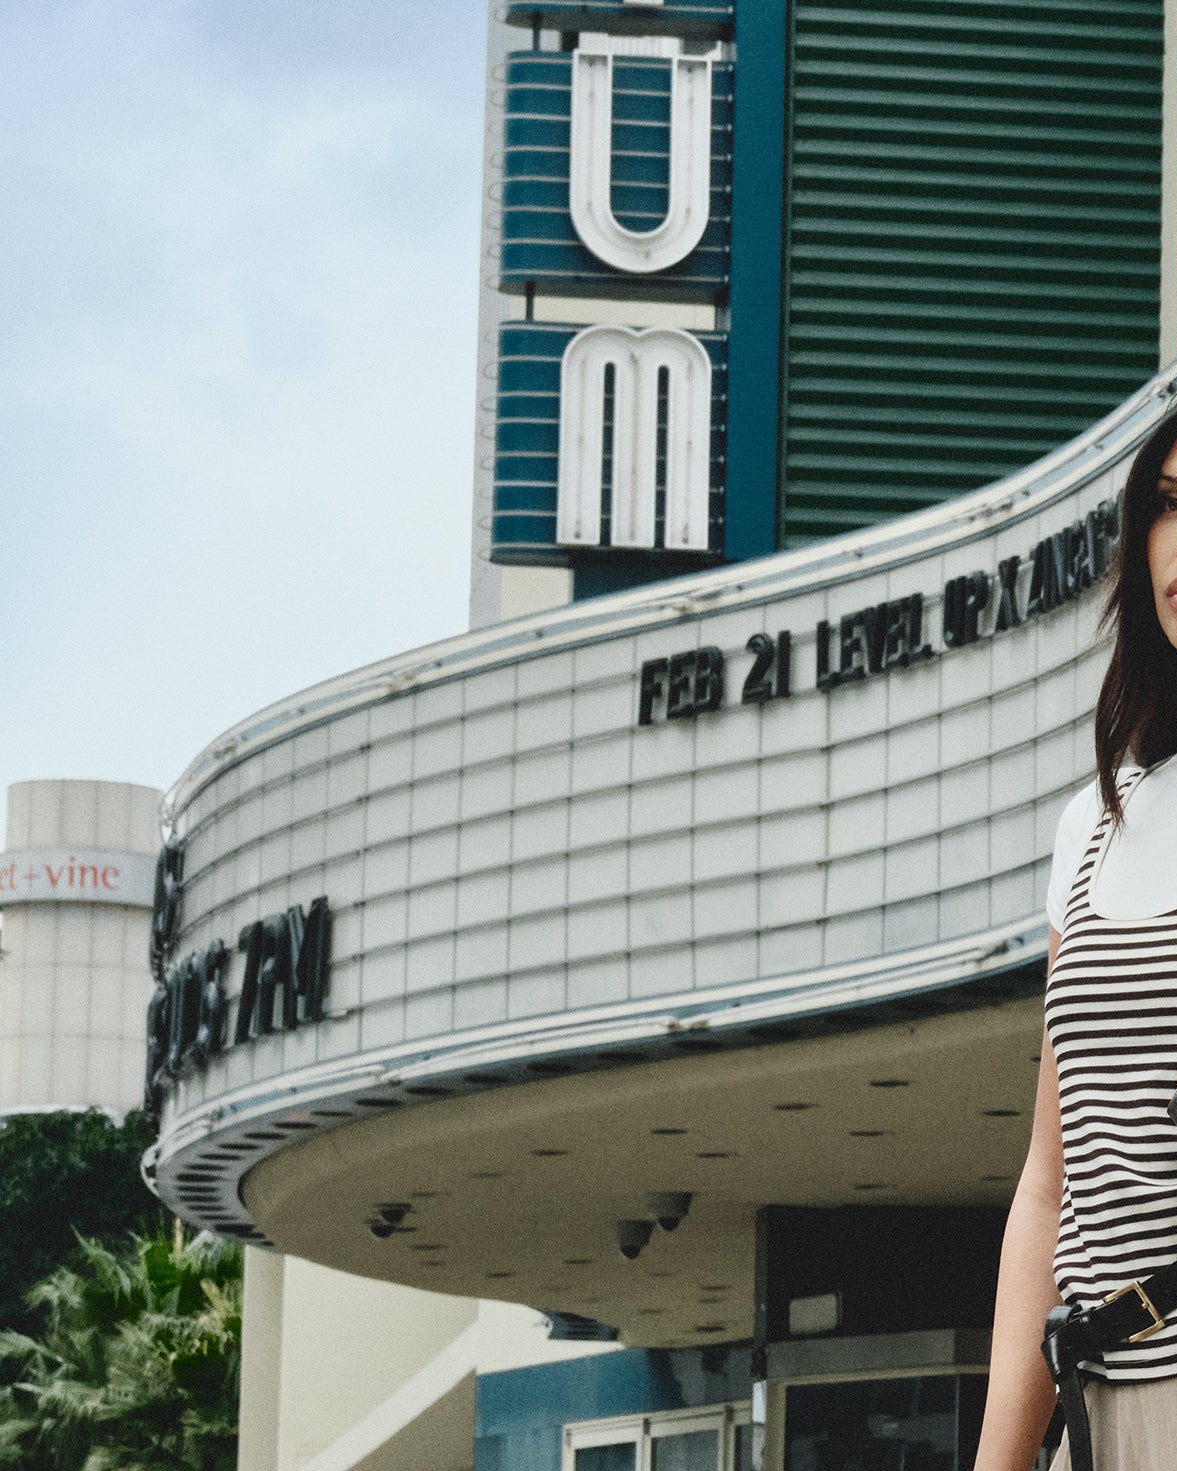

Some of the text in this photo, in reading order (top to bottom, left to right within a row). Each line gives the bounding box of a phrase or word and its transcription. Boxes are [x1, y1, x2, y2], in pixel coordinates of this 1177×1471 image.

[638, 646, 725, 725] FEB
[742, 629, 791, 704] 21
[816, 591, 935, 690] LEVEL
[943, 570, 990, 648] UP
